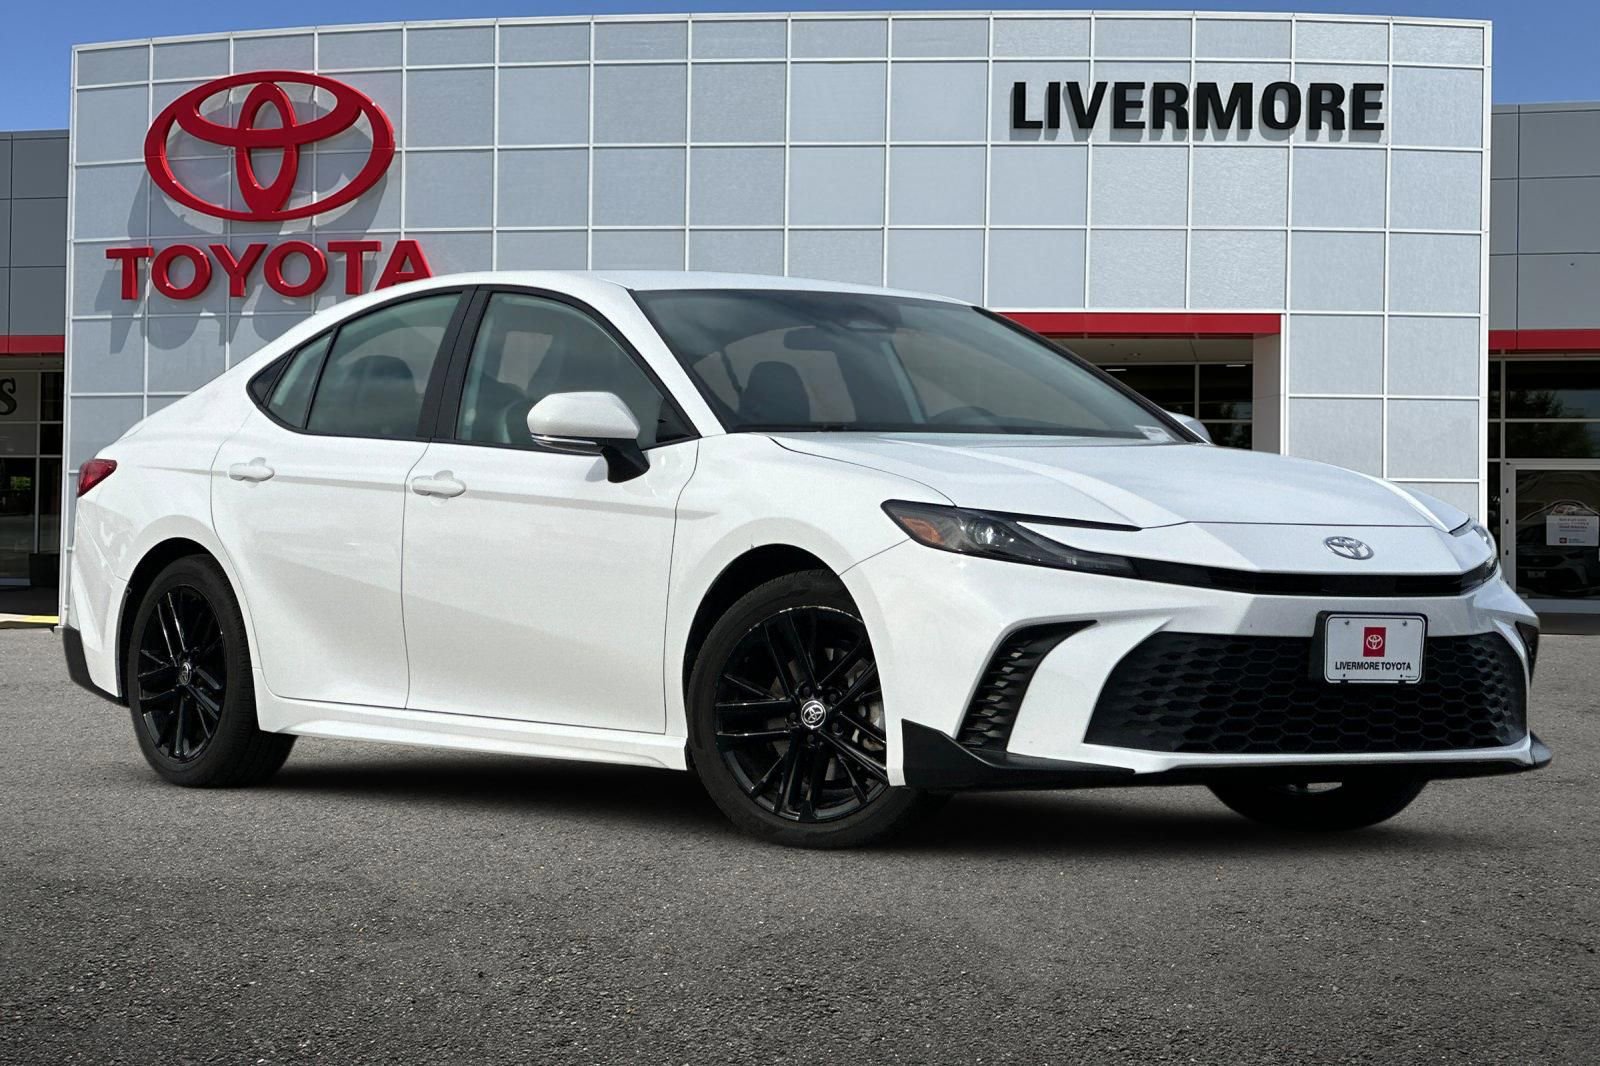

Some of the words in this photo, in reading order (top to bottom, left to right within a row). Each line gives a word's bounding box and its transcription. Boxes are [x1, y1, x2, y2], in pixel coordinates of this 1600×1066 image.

[1012, 81, 1385, 132] LIVERMORE
[106, 240, 432, 300] TOYOTA
[1335, 661, 1380, 671] LIVERMORE
[1381, 661, 1412, 671] TOYOTA
